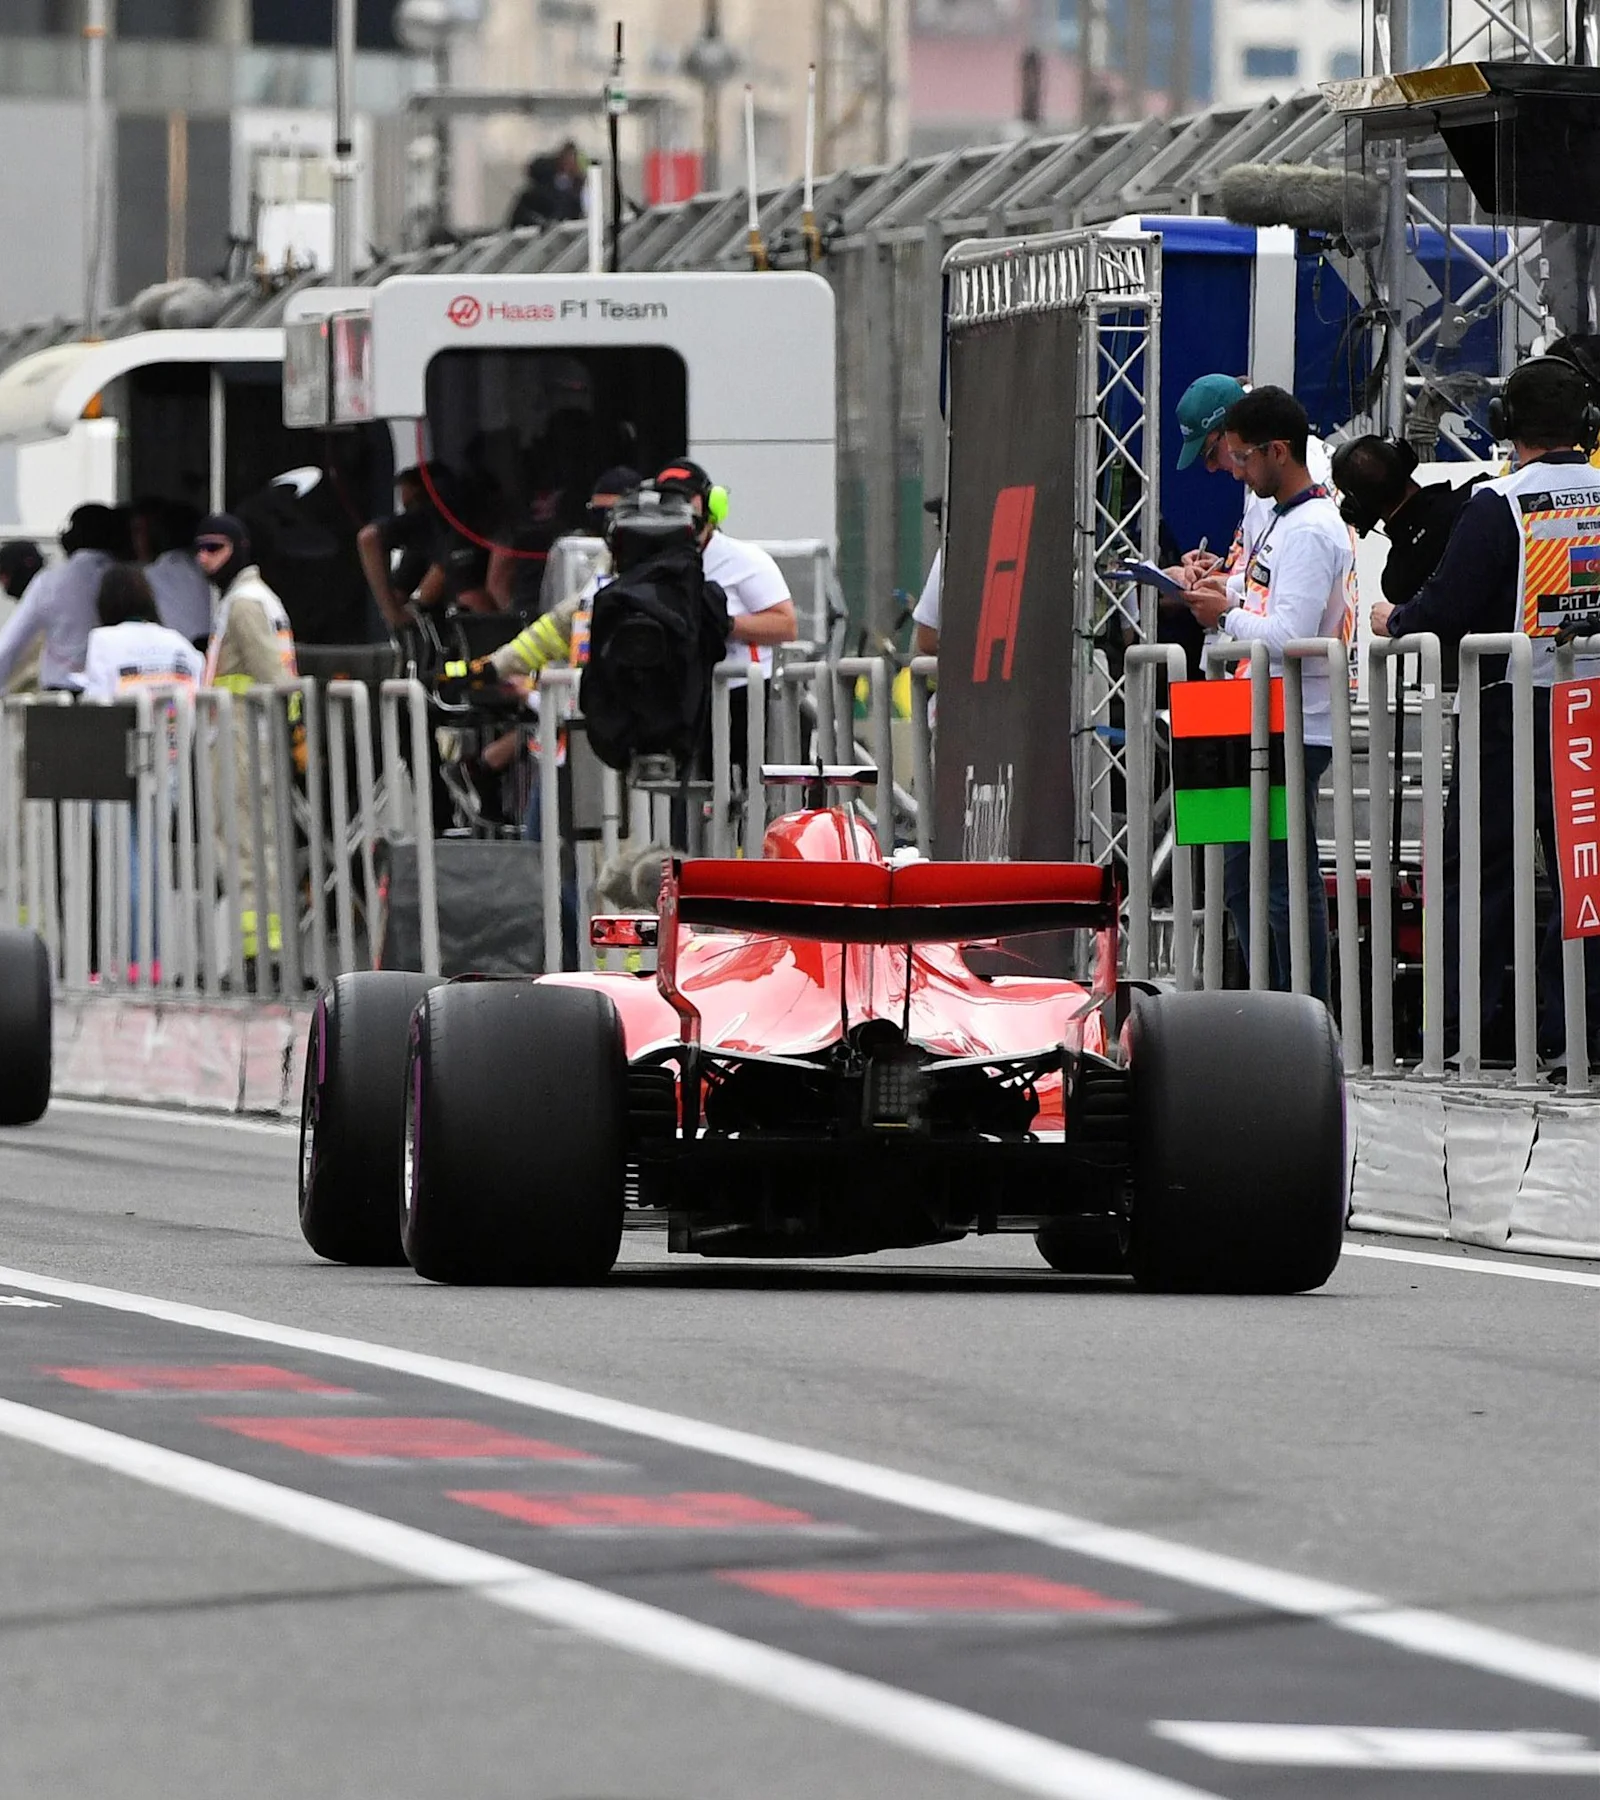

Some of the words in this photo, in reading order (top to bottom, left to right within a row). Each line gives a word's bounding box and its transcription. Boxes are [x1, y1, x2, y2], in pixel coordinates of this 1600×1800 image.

[487, 301, 555, 322] Haas
[560, 299, 588, 319] F1
[596, 298, 669, 321] Team
[1555, 491, 1600, 507] AZB316
[1559, 594, 1584, 610] PIT
[1567, 687, 1600, 929] PREMA
